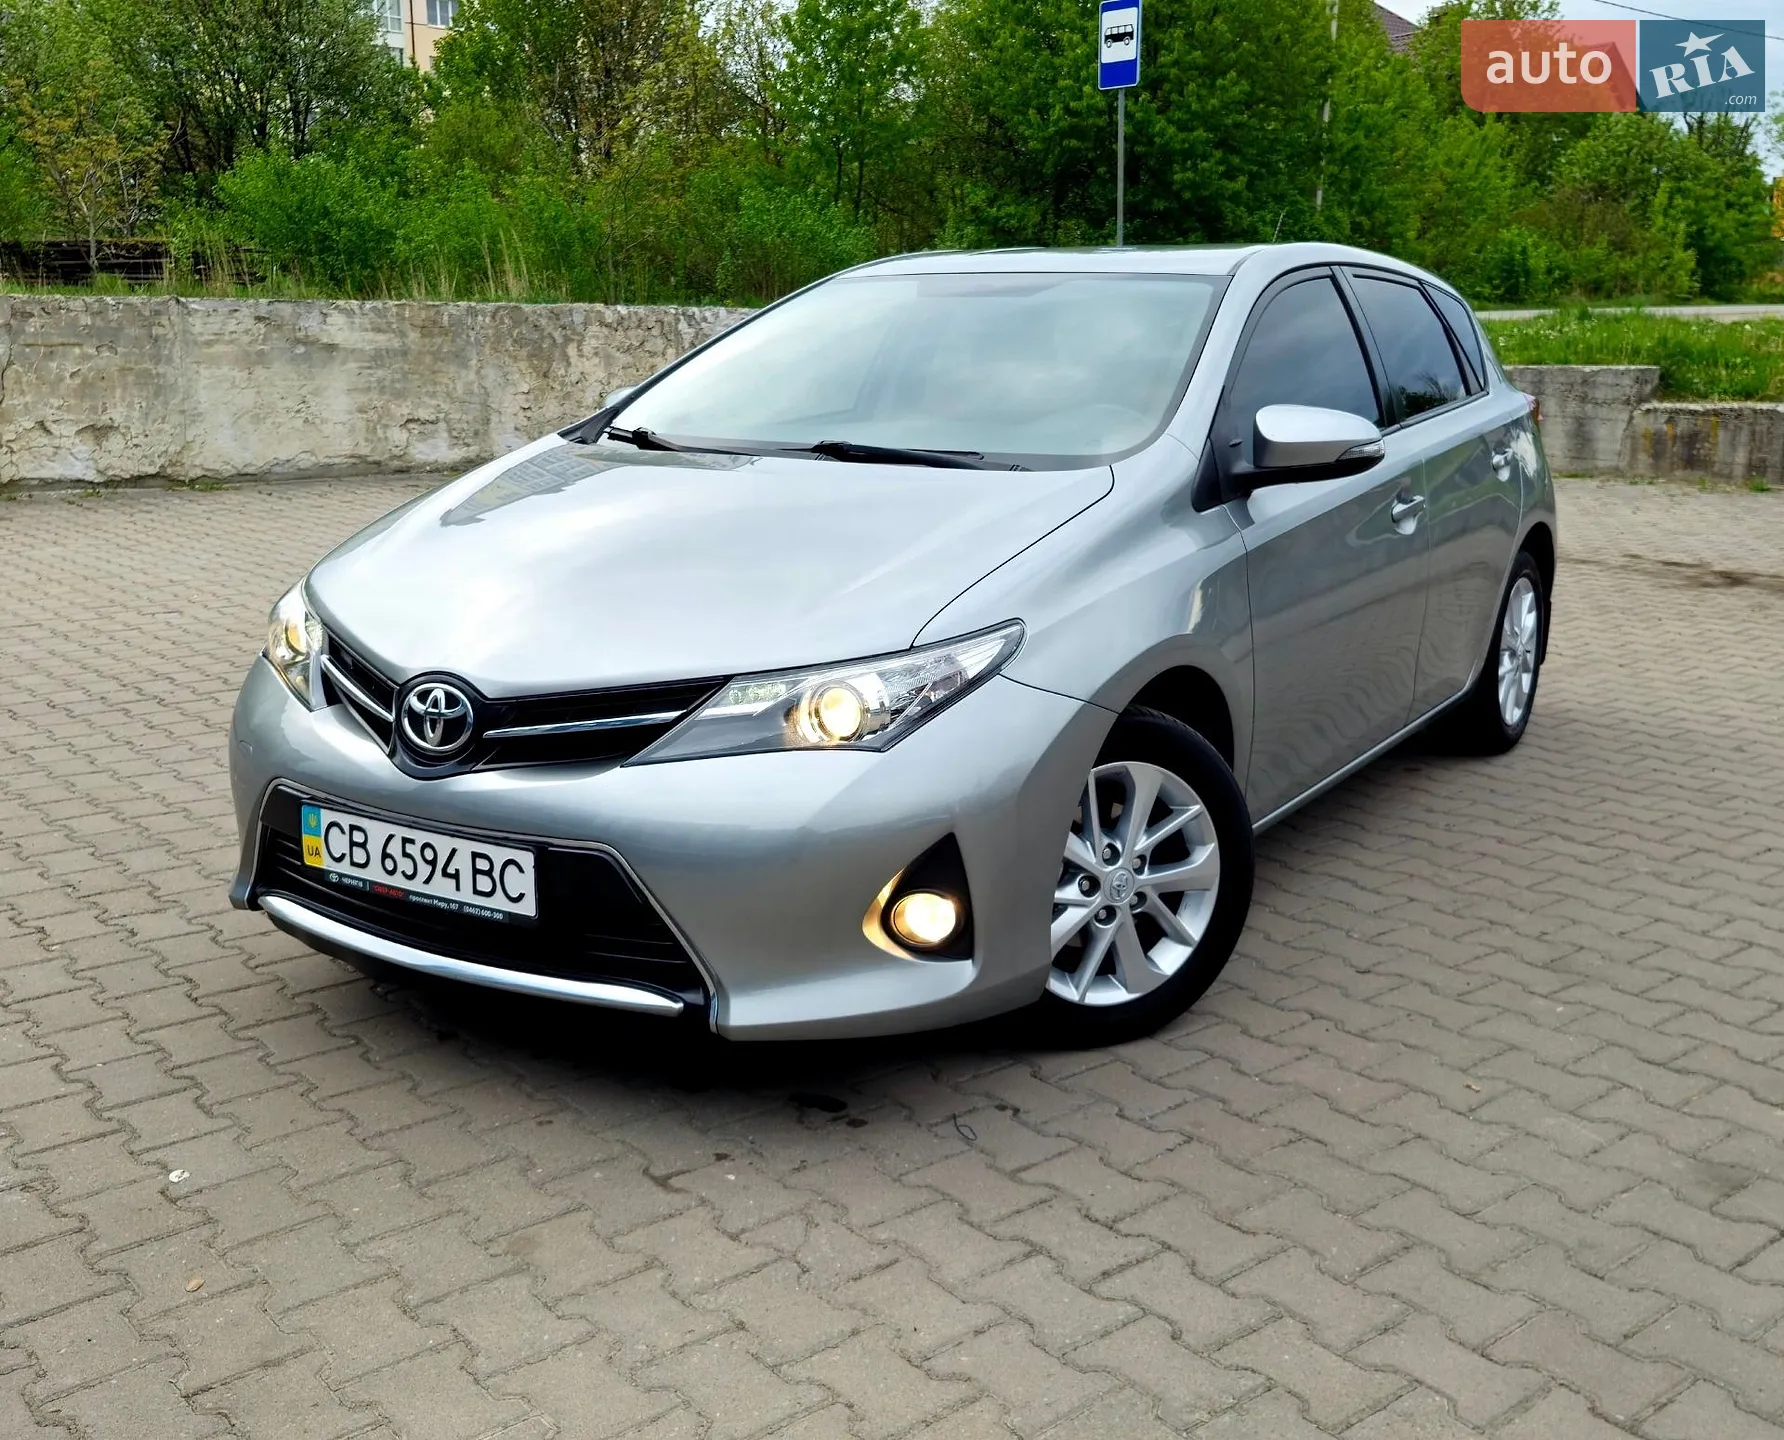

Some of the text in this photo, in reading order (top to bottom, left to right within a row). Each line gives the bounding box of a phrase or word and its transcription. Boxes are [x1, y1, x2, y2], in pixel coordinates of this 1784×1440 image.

[307, 845, 322, 859] UA
[323, 820, 526, 904] CB 6594 BC
